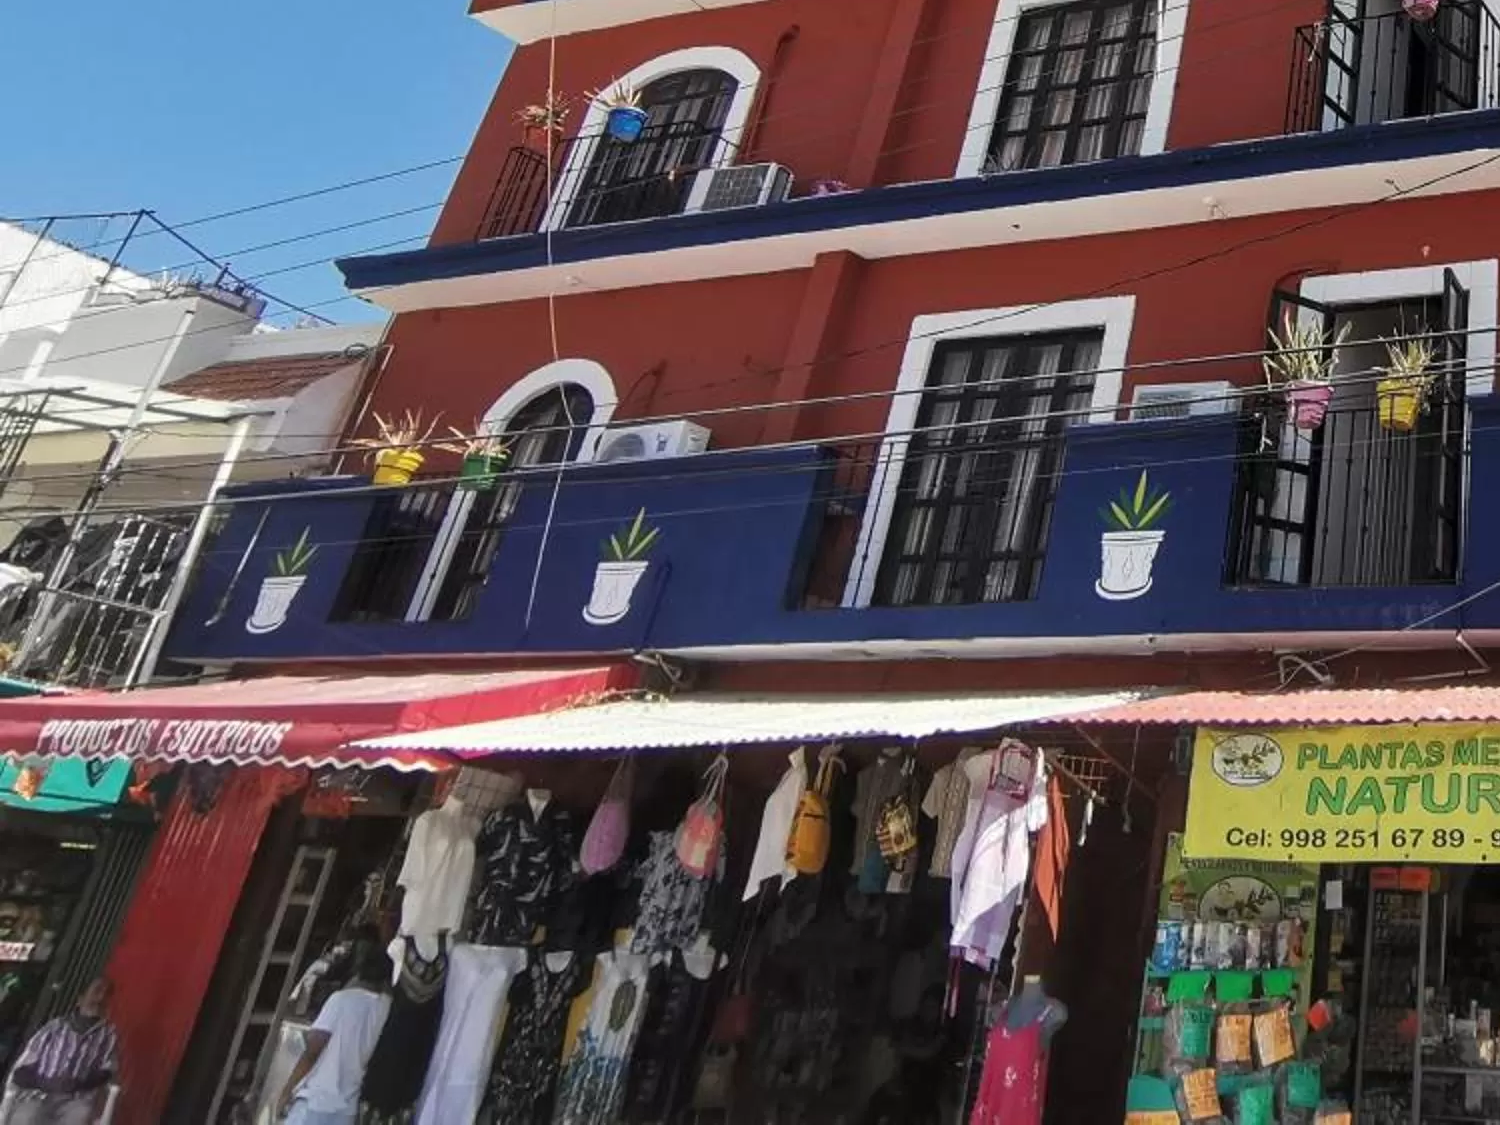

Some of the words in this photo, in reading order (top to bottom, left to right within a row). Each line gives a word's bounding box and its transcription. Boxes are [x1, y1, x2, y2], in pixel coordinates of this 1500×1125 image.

[37, 718, 160, 754] PRODUCTOS
[157, 719, 293, 755] ESOTERICOS
[1297, 740, 1445, 770] PLANTAS
[1226, 827, 1272, 848] Cel:
[1280, 829, 1327, 848] 998
[1335, 829, 1380, 848] 251
[1391, 829, 1425, 848] 67
[1432, 829, 1465, 848] 89
